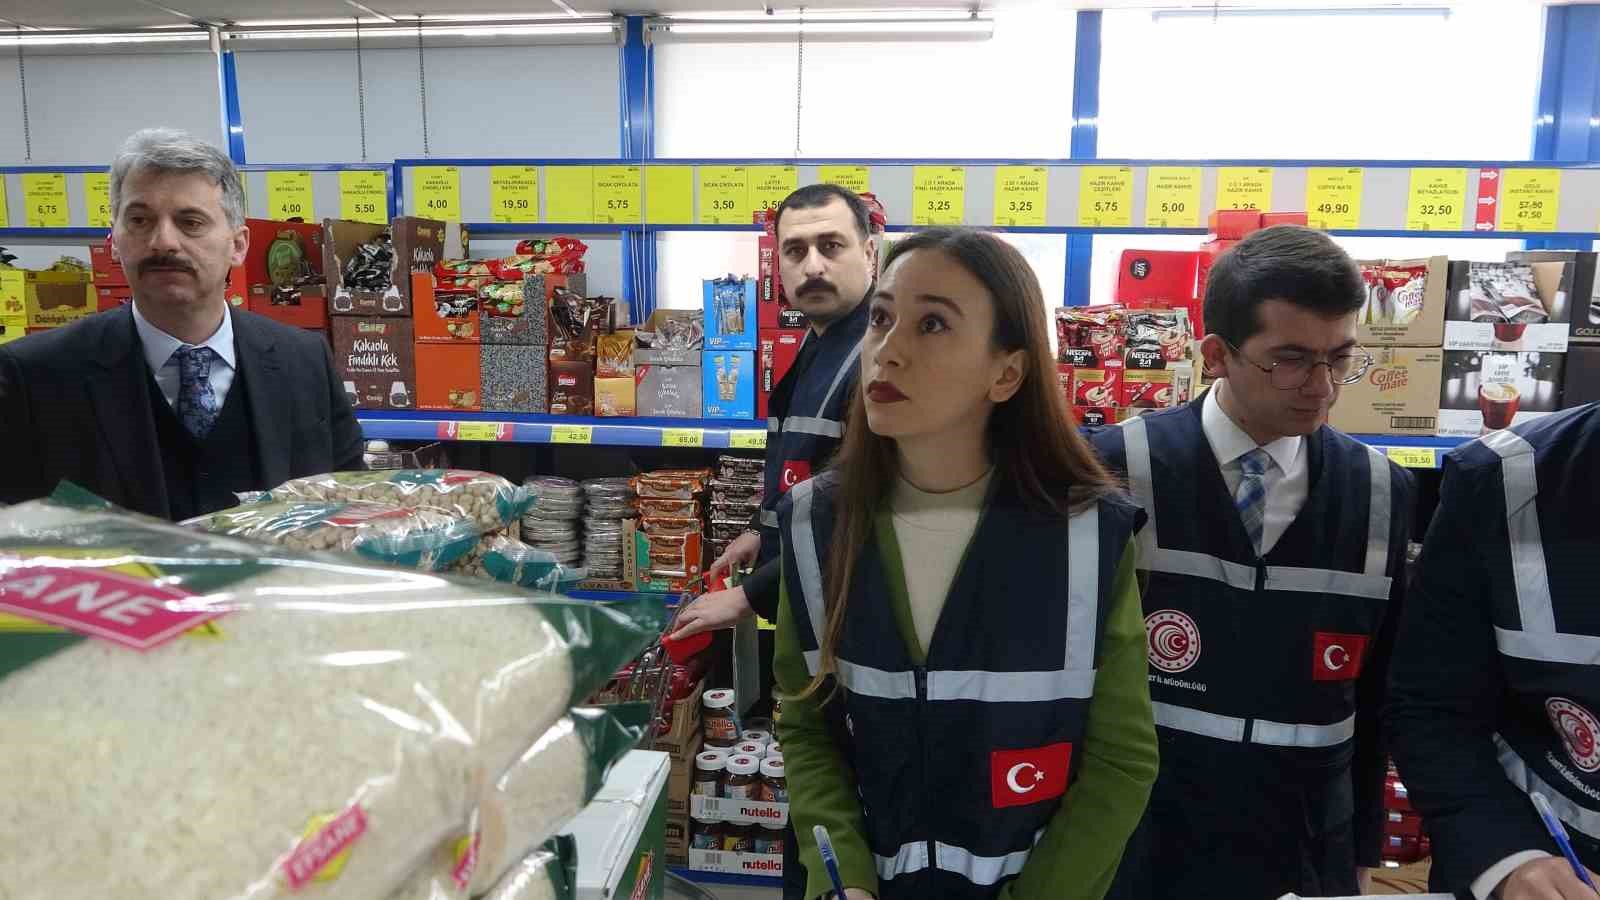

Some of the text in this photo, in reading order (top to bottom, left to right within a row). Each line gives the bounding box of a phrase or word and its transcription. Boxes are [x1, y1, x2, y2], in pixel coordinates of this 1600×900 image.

[281, 204, 301, 213] 4,00
[355, 204, 375, 213] 5,50
[427, 199, 448, 209] 4,00
[503, 199, 528, 209] 19,50
[607, 199, 629, 209] 5,75
[713, 200, 735, 210] 3,50
[928, 201, 951, 211] 3,25
[1009, 201, 1032, 211] 3,25
[1095, 202, 1118, 212] 5,75
[1161, 203, 1185, 213] 5,00
[1318, 204, 1349, 214] 49,90
[38, 205, 57, 214] 6,75
[1420, 204, 1452, 215] 32,50
[1518, 211, 1542, 219] 47,50
[740, 807, 781, 818] nutella
[742, 860, 782, 871] nutella
